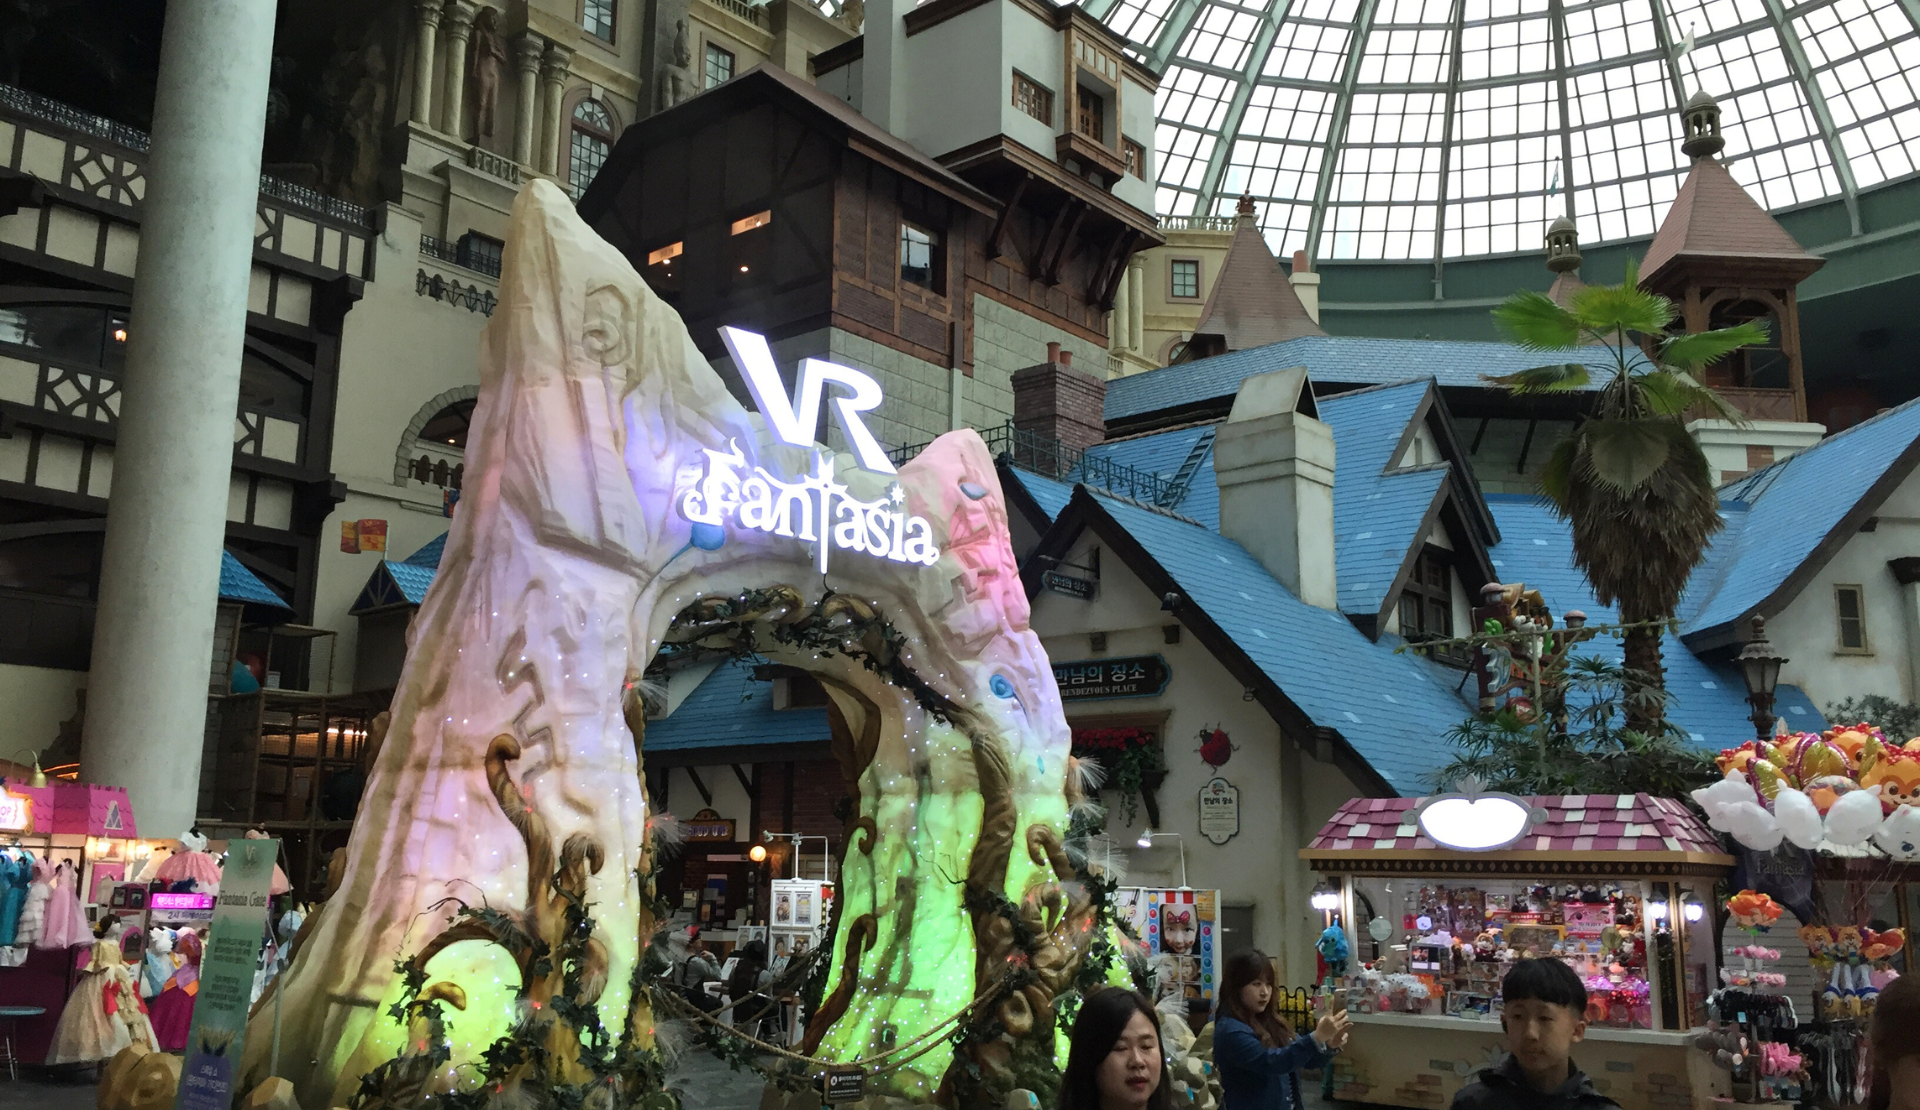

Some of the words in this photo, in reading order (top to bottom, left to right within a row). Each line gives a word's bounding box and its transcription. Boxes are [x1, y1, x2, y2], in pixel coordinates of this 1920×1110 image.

[717, 325, 898, 474] VR
[679, 437, 940, 574] Fantasia
[1054, 666, 1103, 685] 만남의
[1111, 662, 1145, 682] 장소
[1061, 686, 1110, 697] RENDEZVOUS
[1112, 684, 1138, 694] PLACE
[218, 890, 248, 906] Fantasia
[249, 891, 267, 907] Gate
